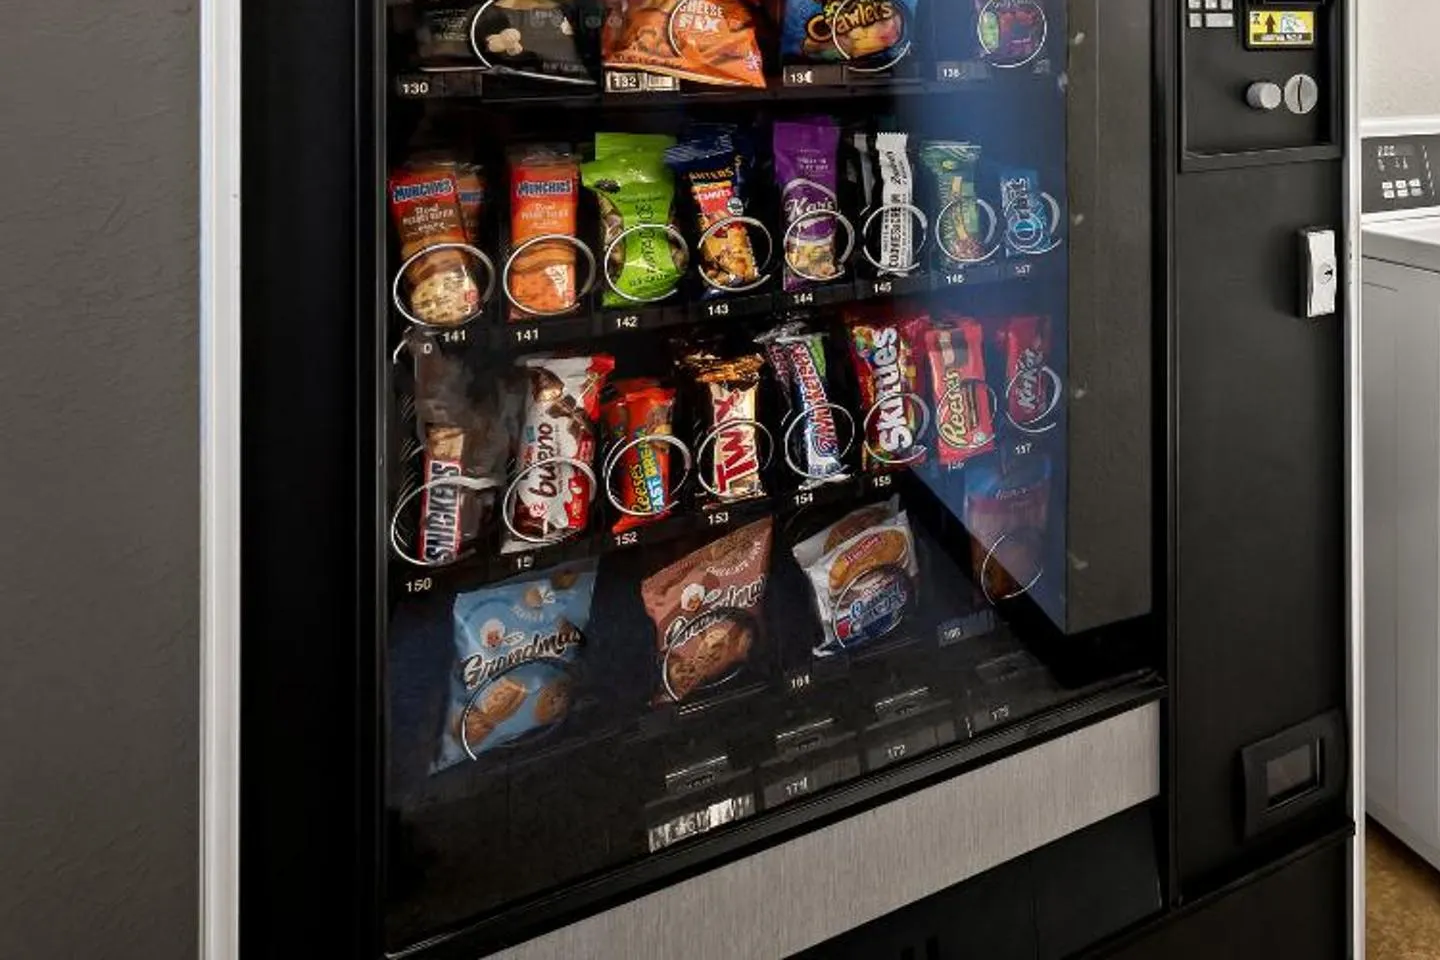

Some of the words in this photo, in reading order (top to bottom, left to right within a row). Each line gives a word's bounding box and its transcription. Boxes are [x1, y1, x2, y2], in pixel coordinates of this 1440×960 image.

[403, 81, 430, 95] 130
[613, 75, 637, 88] 132
[794, 293, 813, 304] 144
[708, 303, 729, 316] 143
[616, 316, 639, 329] 142
[515, 328, 539, 342] 141
[713, 389, 761, 495] TWX
[526, 422, 558, 498] bueno
[425, 462, 459, 563] SNICKES
[615, 531, 638, 546] 152
[405, 578, 432, 593] 150
